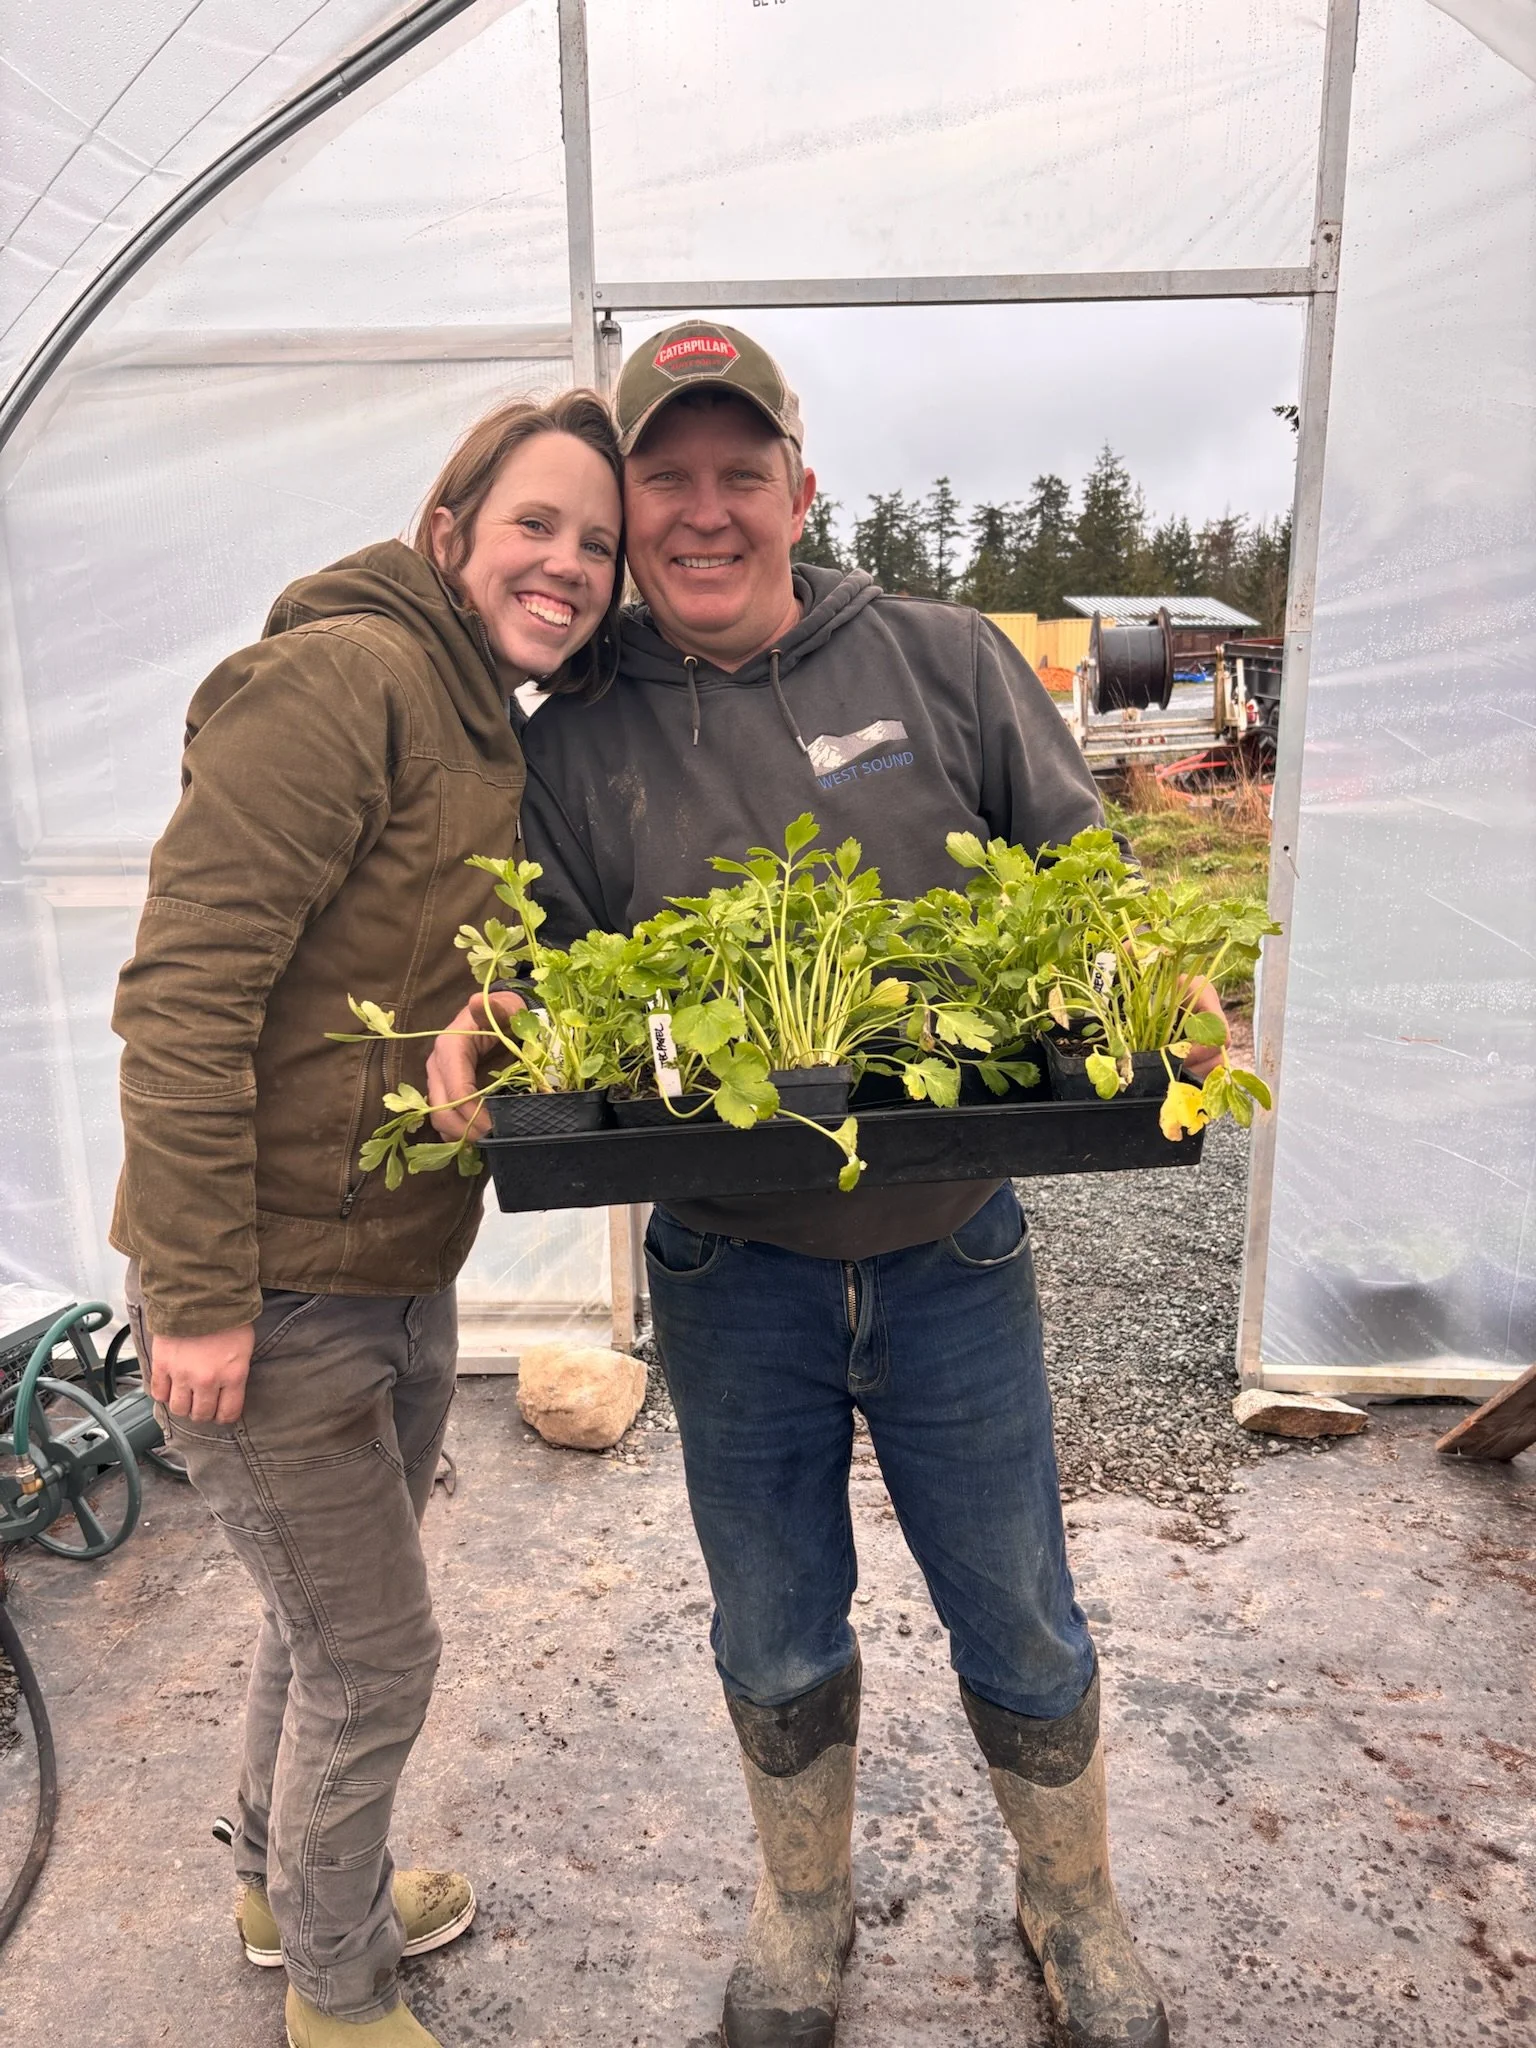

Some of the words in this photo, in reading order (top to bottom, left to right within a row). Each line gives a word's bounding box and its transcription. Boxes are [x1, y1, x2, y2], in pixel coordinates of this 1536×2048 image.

[660, 340, 728, 362] CATERPILLAR
[818, 766, 858, 789] WEST
[862, 752, 914, 775] SOUND
